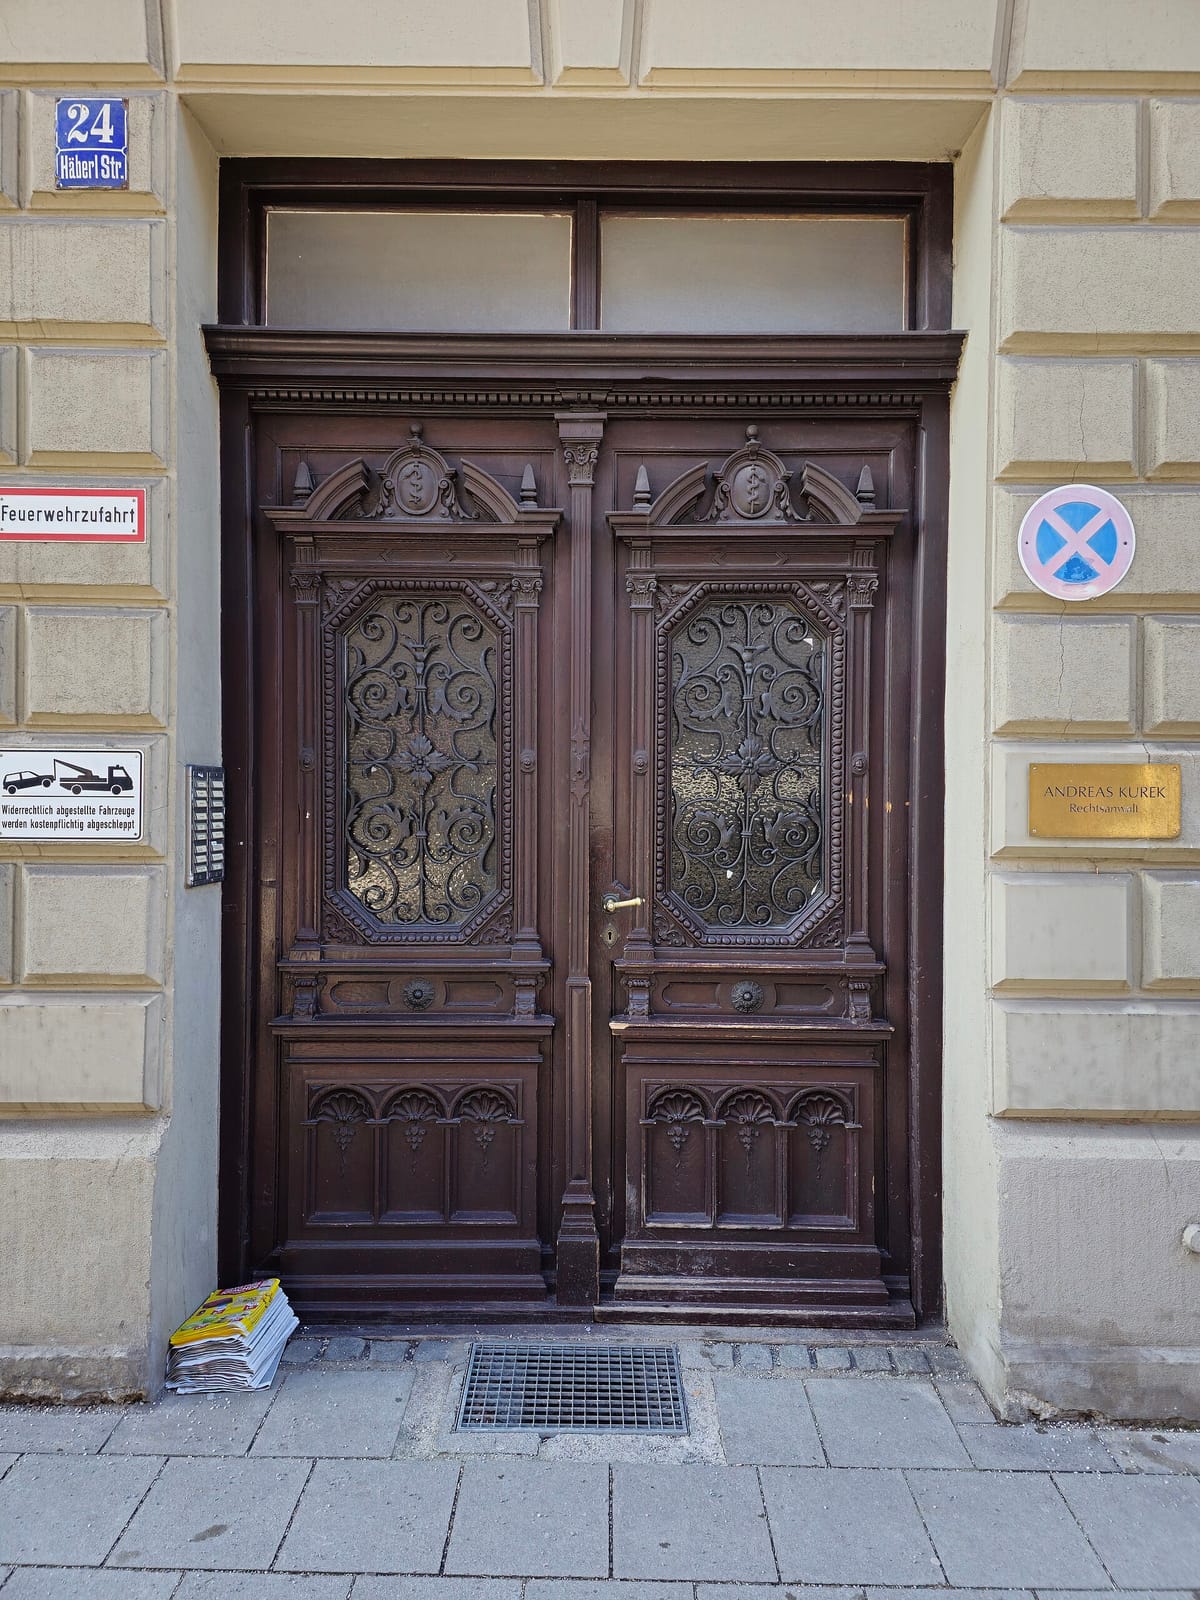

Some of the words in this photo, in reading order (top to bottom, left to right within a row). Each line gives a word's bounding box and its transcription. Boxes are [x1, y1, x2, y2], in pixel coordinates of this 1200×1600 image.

[67, 103, 114, 144] 24
[60, 154, 98, 179] Häberl
[101, 154, 124, 179] Str.
[1, 505, 135, 523] Feuerwehrzufahrt
[1044, 785, 1114, 798] ANDREAS
[1119, 786, 1166, 799] KUREK
[1, 804, 53, 815] Widerrechtlich
[56, 805, 96, 817] abgestellte
[98, 805, 135, 817] Fahrzeuge
[1069, 803, 1139, 814] Rechtsanwalt
[2, 819, 28, 829] werden
[30, 819, 84, 831] kostenpflichtig
[87, 819, 135, 831] abgeschleppt
